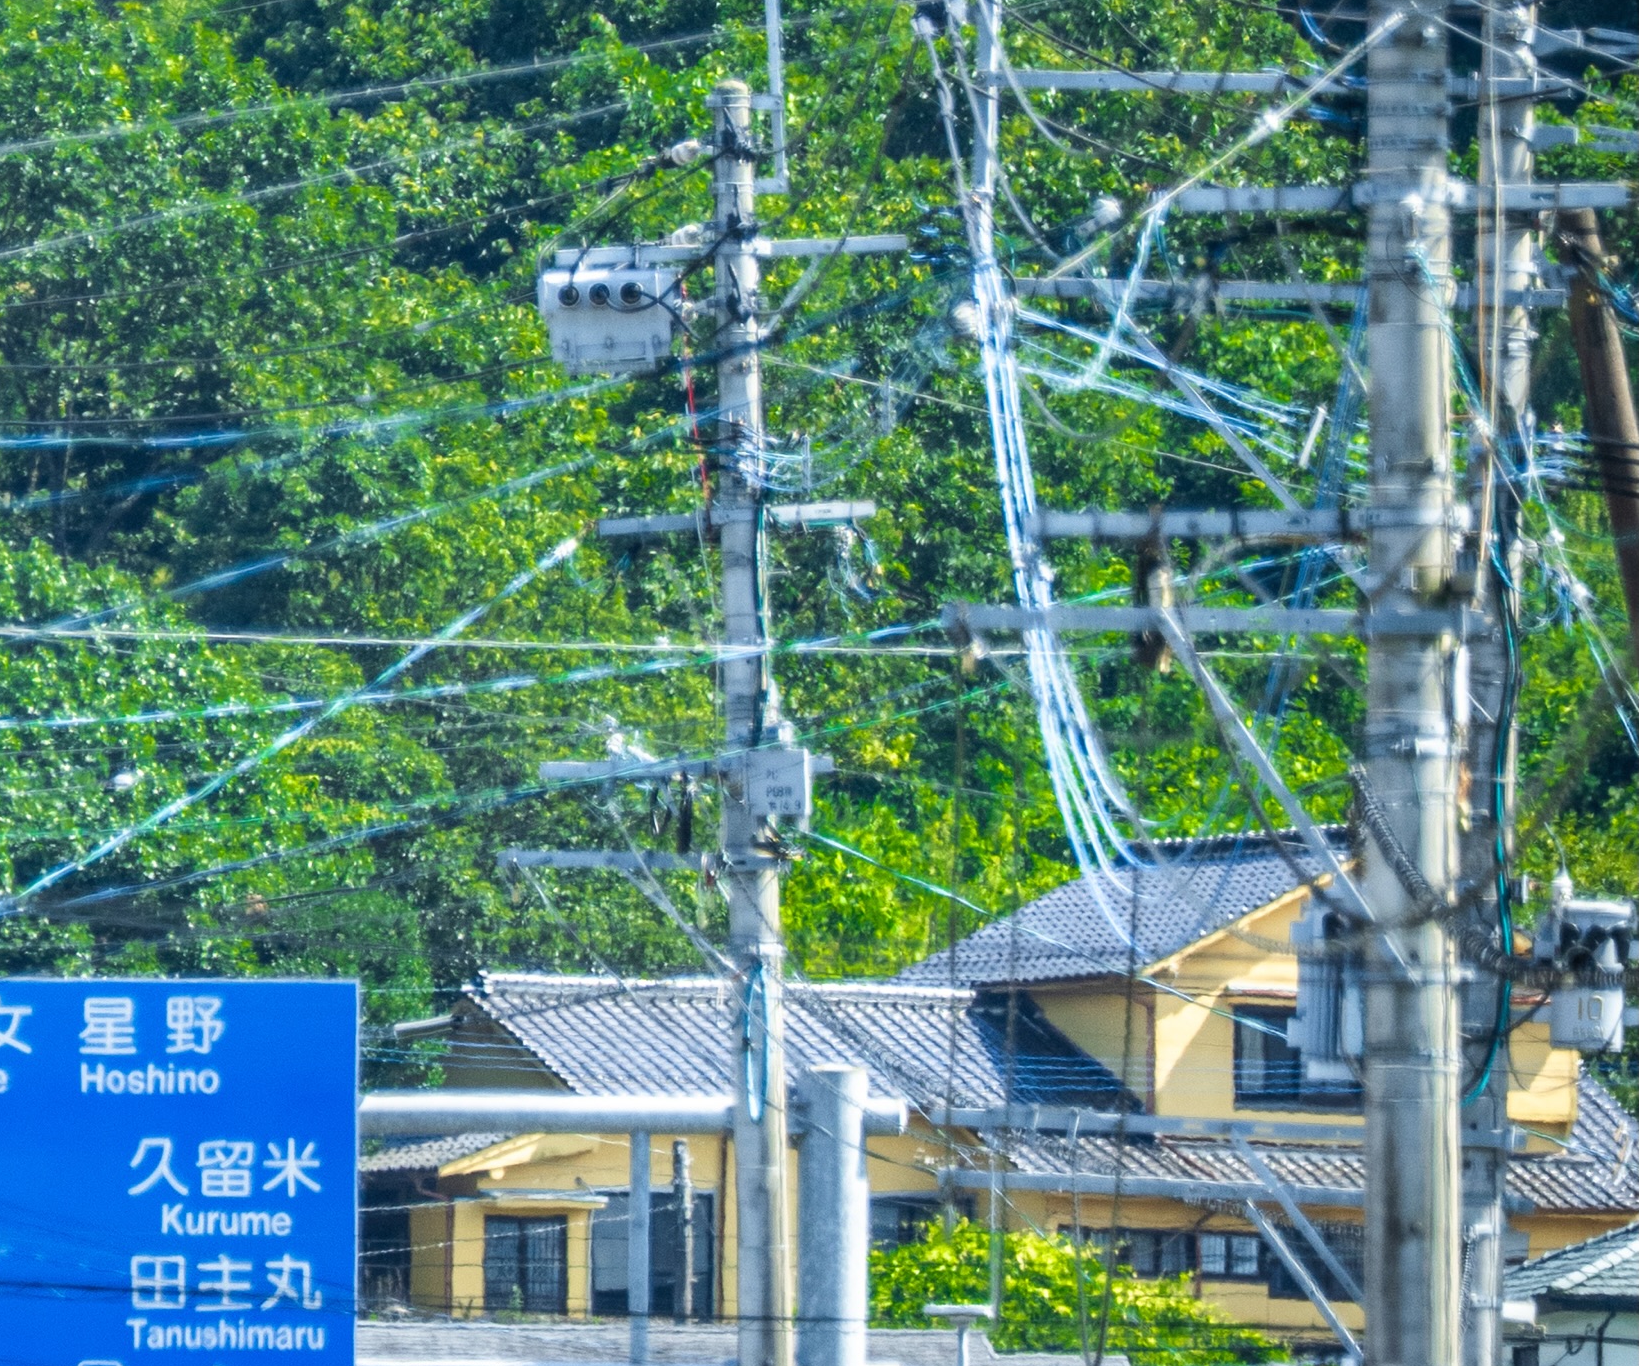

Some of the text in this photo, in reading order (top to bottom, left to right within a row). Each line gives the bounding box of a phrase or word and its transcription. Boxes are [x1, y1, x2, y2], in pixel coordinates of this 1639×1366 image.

[79, 996, 225, 1054] 星野
[80, 1064, 220, 1094] Hoshino
[128, 1138, 321, 1197] 久留米
[161, 1204, 292, 1236] Kurume
[130, 1254, 322, 1312] 田主丸
[126, 1319, 325, 1351] Tanushimaru
